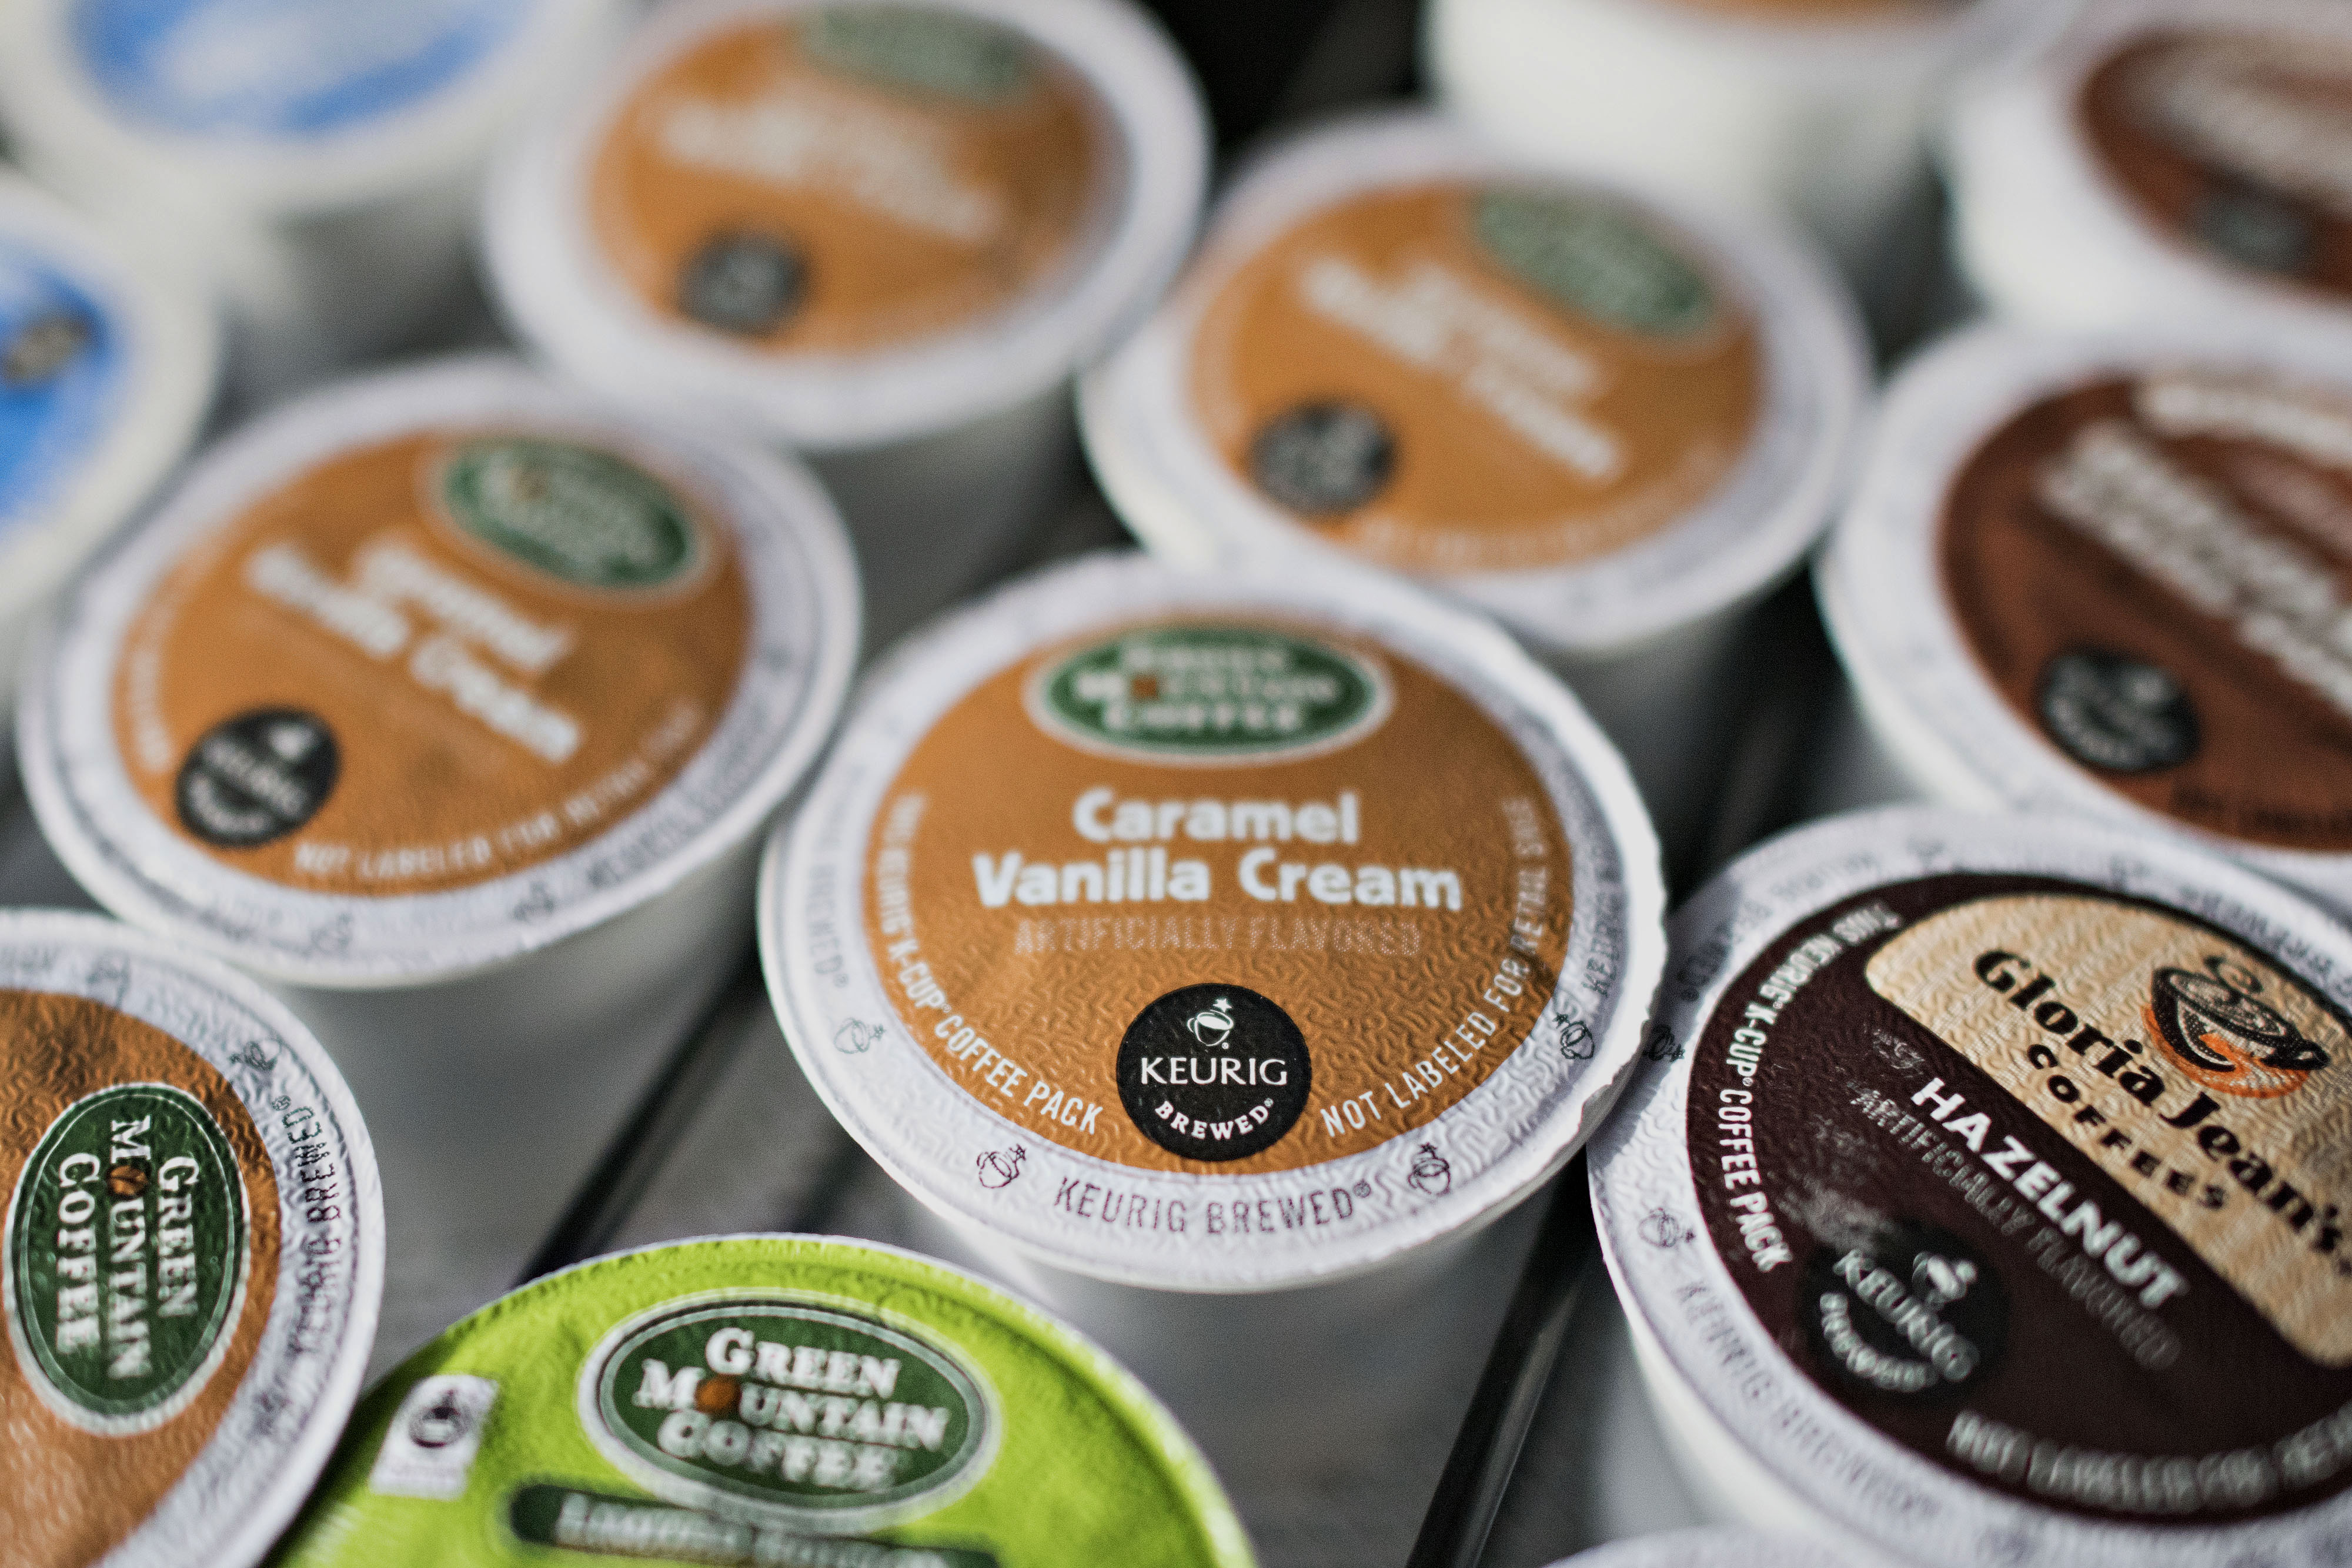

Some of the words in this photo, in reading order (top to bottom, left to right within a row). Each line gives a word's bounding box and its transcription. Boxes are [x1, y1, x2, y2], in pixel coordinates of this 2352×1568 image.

[1073, 786, 1359, 845] Caramel
[973, 847, 1210, 908] Vanilla
[1238, 847, 1461, 911] Cream
[1014, 915, 1238, 955] ARTIFICIALLY
[1250, 917, 1421, 956] FLAVORED
[936, 1015, 1028, 1098] COFFEE
[1023, 1080, 1103, 1135] PACK
[1141, 1057, 1287, 1085] KEURIG
[1320, 1091, 1381, 1136] NOT
[1385, 1011, 1496, 1109] LABELED
[1484, 958, 1529, 1012] FOR
[1973, 950, 2166, 1108] Gloria
[1718, 1088, 1761, 1191] COFFEE
[2027, 1044, 2227, 1211] COFFEES
[158, 1156, 199, 1317] GREEN
[1054, 1177, 1187, 1232] KEURIG
[1729, 1191, 1793, 1273] PACK
[1911, 1077, 2189, 1309] HAZELNUT
[56, 1153, 101, 1353] COFFEE
[108, 1115, 152, 1378] MOUNTAIN
[632, 1358, 951, 1451] MOUNTAIN
[705, 1327, 901, 1399] GREEN
[657, 1410, 897, 1493] COFFEE
